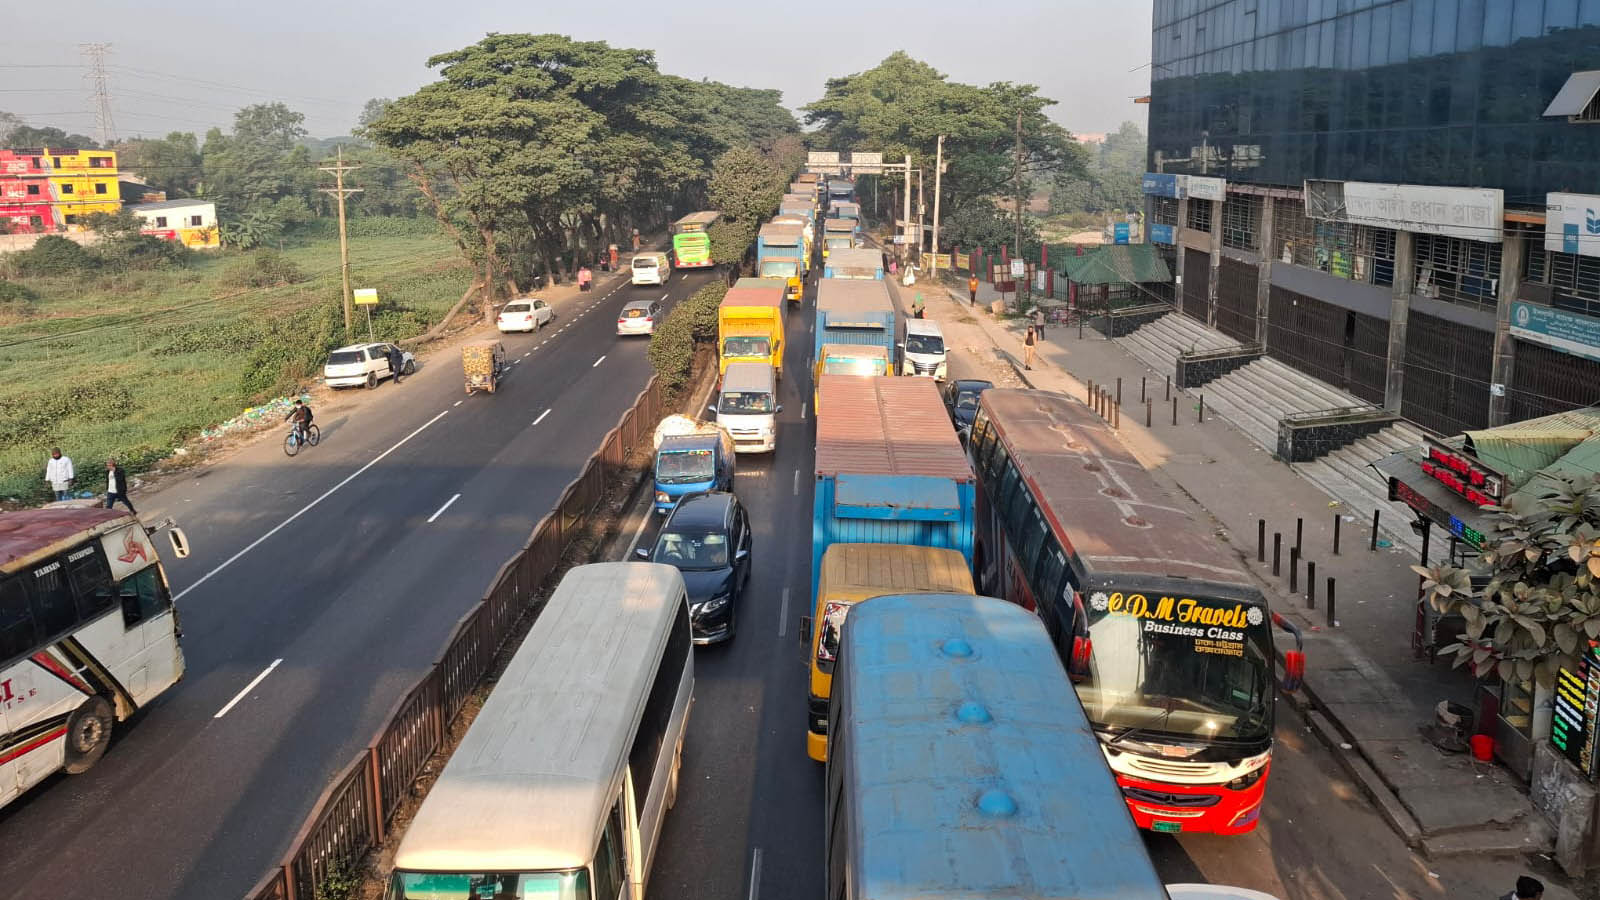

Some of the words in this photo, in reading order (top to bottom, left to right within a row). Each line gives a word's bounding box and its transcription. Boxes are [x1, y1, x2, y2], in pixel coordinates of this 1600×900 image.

[1177, 598, 1248, 629] Travels
[1144, 621, 1204, 637] Business
[1207, 627, 1244, 640] Class
